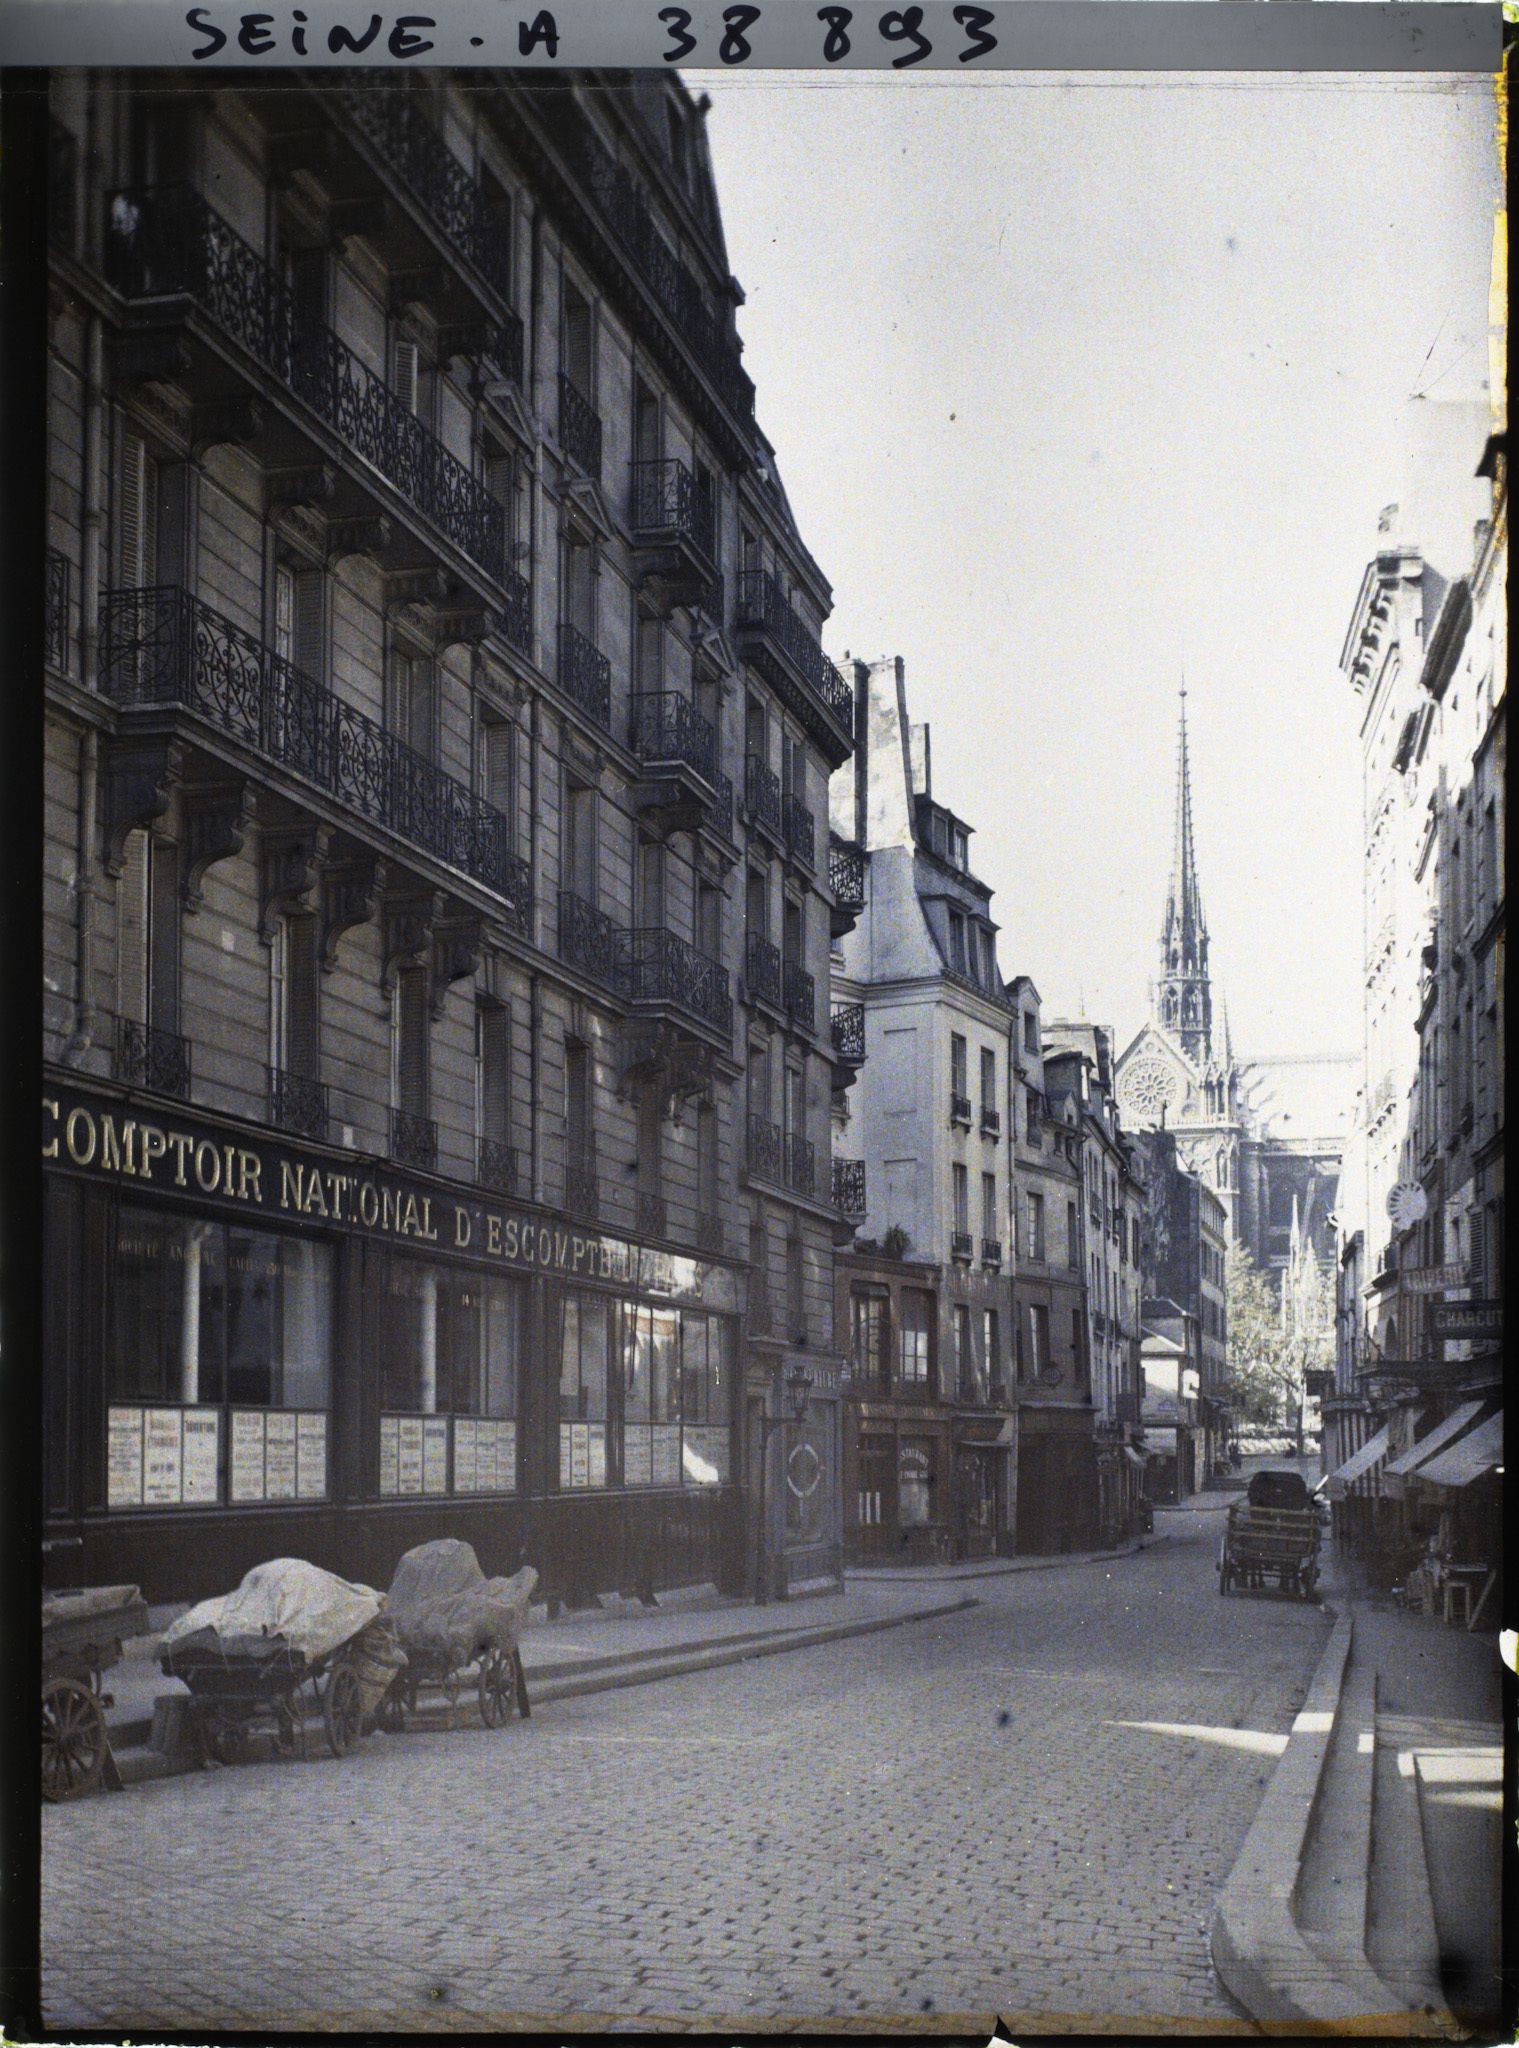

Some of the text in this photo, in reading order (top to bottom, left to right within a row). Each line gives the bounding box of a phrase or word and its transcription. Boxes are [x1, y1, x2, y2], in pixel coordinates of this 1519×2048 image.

[518, 10, 560, 59] A
[658, 6, 762, 65] 38
[817, 5, 998, 67] 893
[42, 1098, 263, 1204] COMPTOIR
